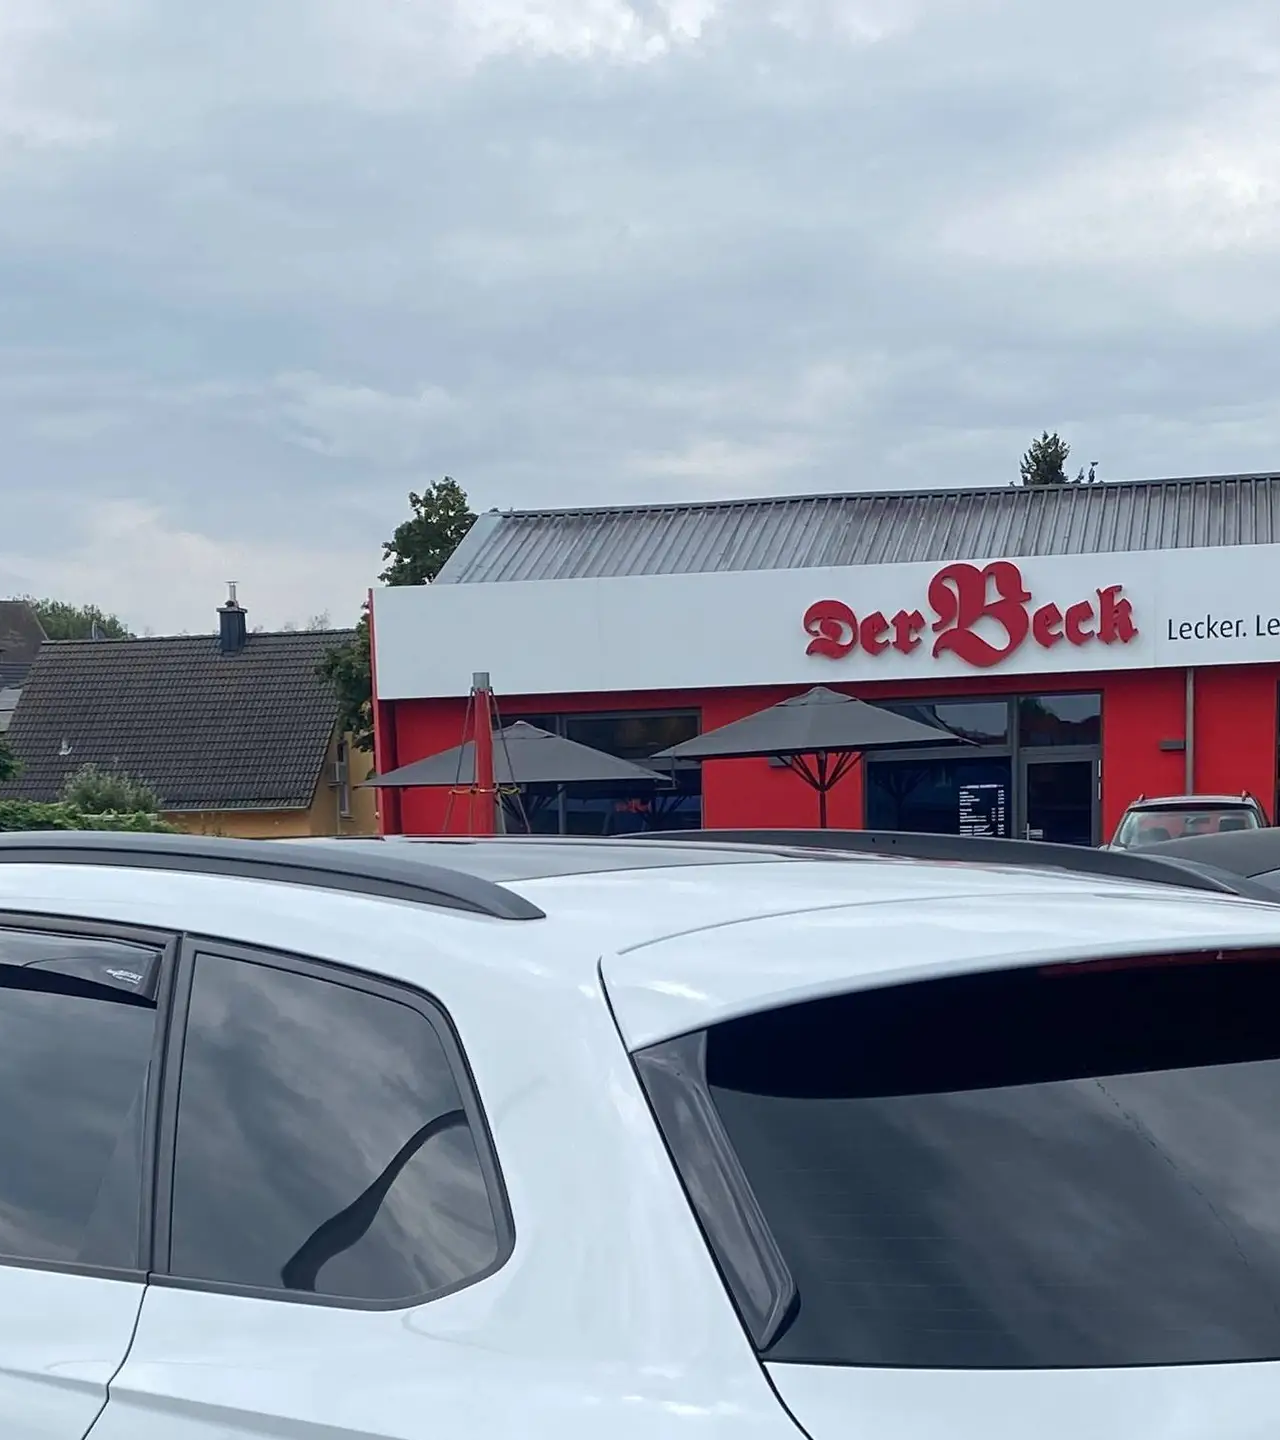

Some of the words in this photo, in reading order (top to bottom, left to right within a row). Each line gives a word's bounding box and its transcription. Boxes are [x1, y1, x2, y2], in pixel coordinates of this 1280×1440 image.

[803, 599, 926, 660] Der
[927, 560, 1140, 668] Beck
[1168, 614, 1248, 641] Lecker.
